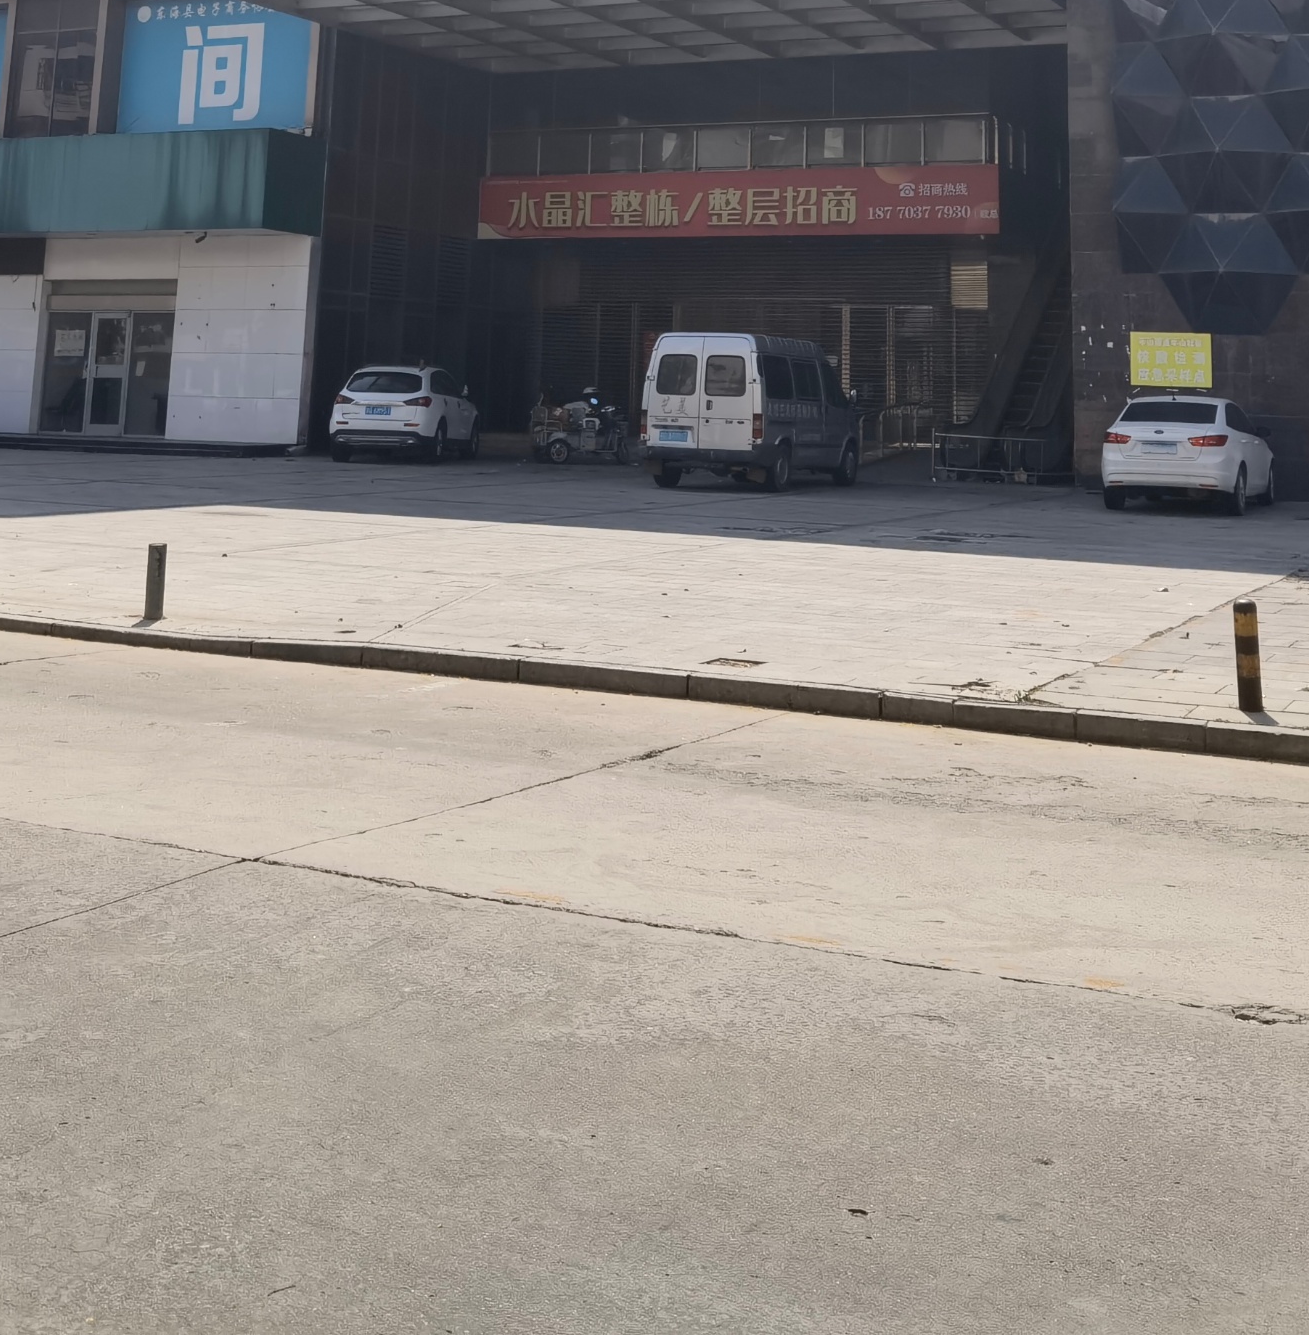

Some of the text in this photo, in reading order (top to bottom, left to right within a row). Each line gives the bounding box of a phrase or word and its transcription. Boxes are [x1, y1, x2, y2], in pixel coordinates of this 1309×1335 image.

[155, 0, 276, 20] 东海县电子商务协
[918, 182, 969, 197] 招商热线
[867, 205, 893, 220] 187
[896, 205, 931, 219] 7037
[935, 205, 971, 218] 7930
